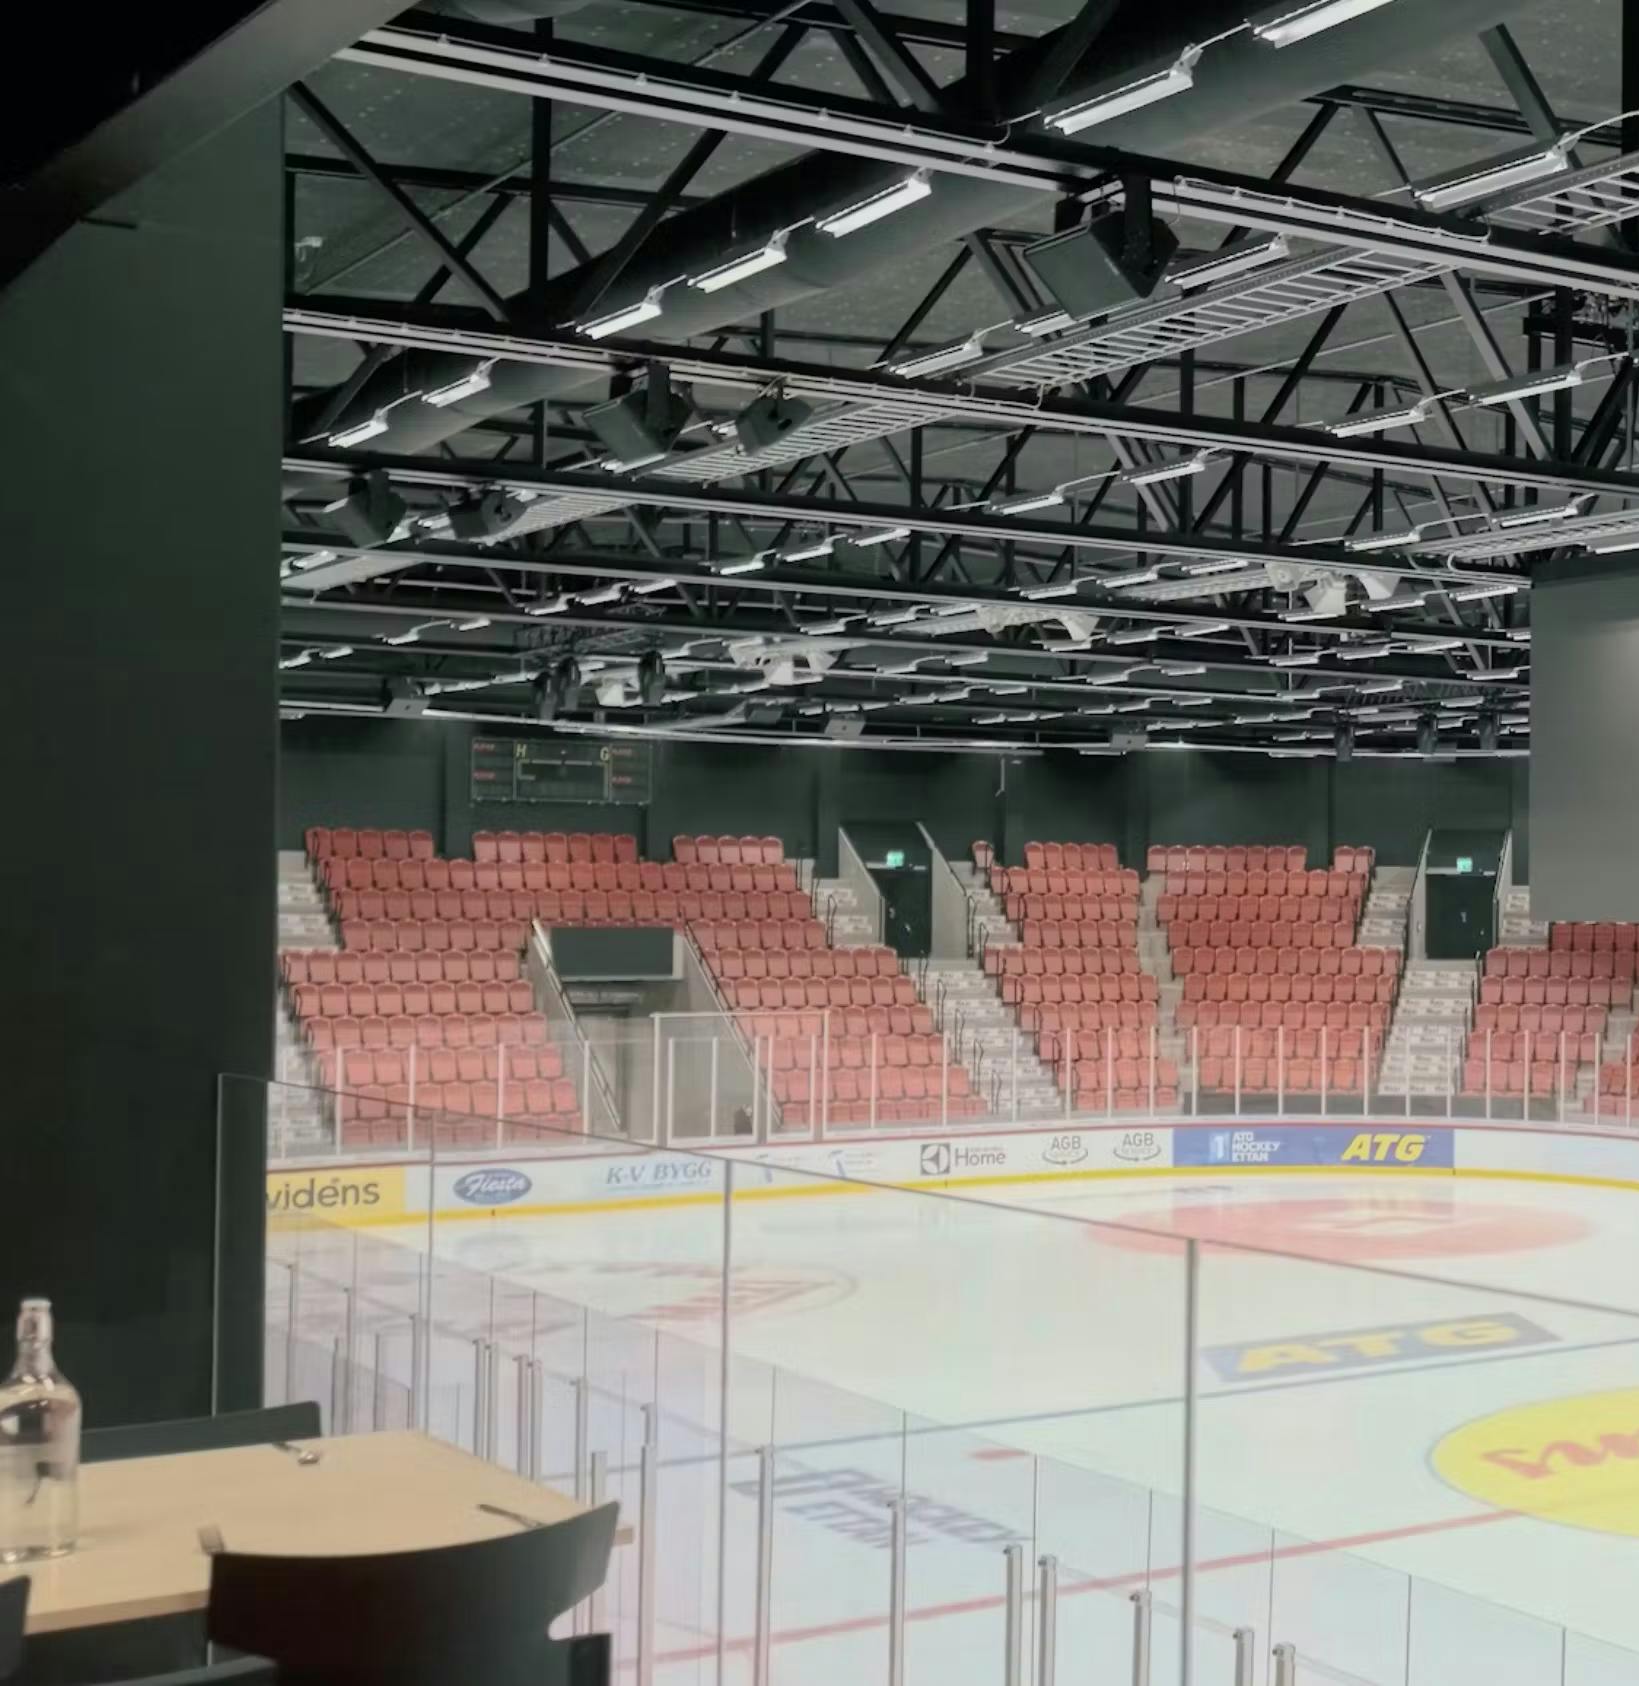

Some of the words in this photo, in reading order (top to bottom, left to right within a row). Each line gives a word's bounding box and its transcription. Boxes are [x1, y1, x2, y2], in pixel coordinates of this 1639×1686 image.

[516, 744, 527, 757] H
[1050, 1135, 1082, 1151] AGB
[1122, 1132, 1155, 1148] AGB
[1232, 1141, 1281, 1153] HOCKEY
[1341, 1134, 1425, 1161] ATG
[954, 1147, 1006, 1168] Home
[653, 1160, 713, 1182] BYGG
[1237, 1318, 1518, 1374] ATG
